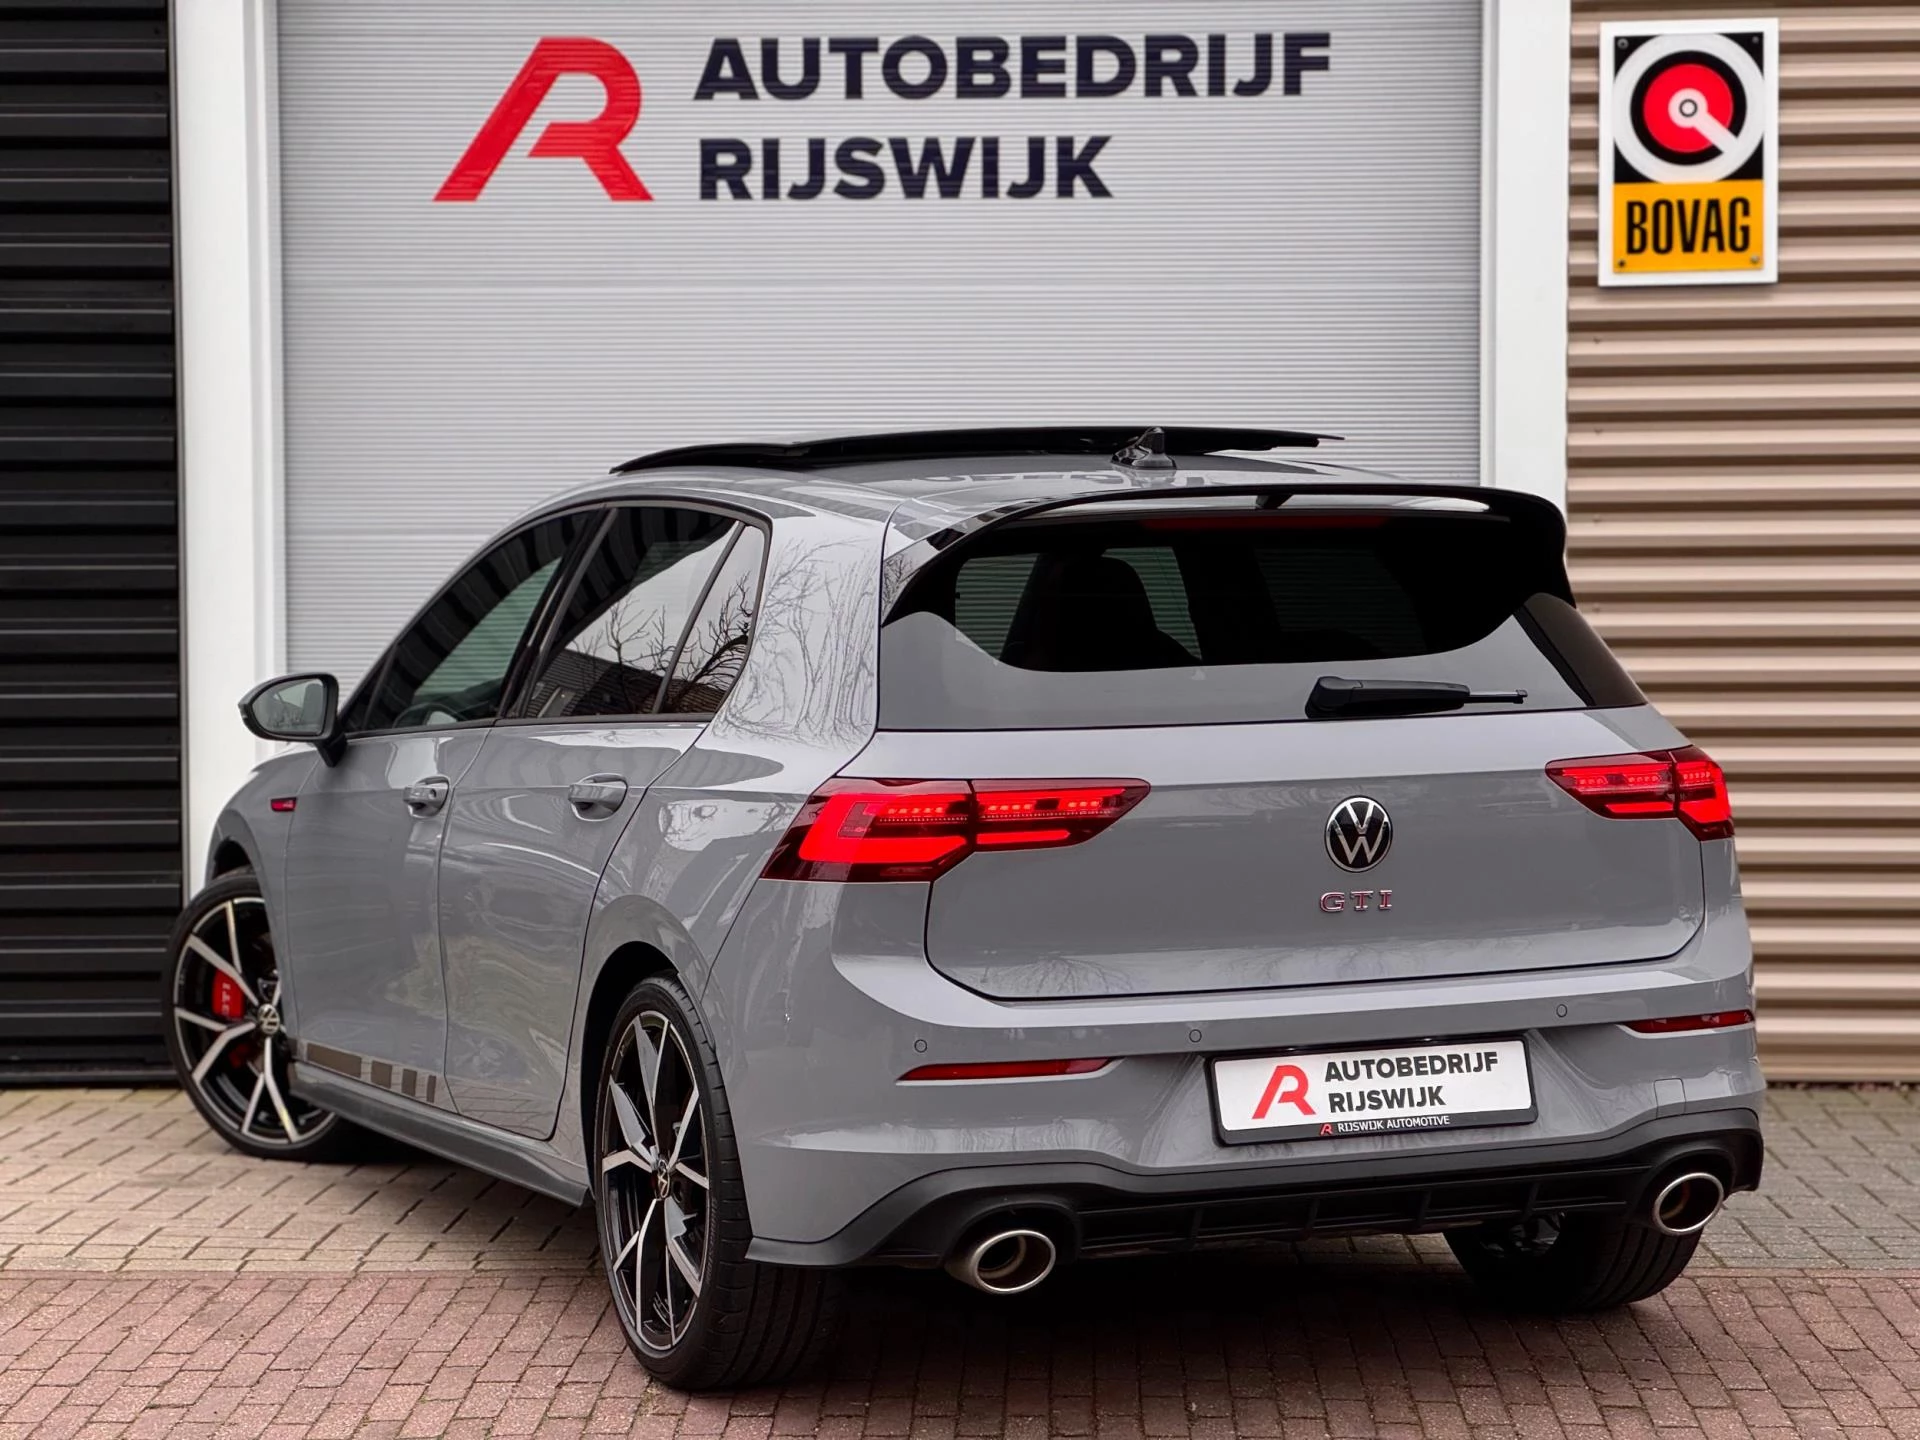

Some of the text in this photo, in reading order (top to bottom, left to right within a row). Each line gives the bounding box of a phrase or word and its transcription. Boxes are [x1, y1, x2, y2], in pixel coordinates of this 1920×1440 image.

[694, 32, 1331, 101] AUTOBEDRIJF
[700, 135, 1115, 201] RIJSWIJK
[1626, 197, 1751, 255] BOVAG
[1320, 889, 1393, 912] GTI
[1324, 1052, 1499, 1082] AUTOBEDRIJF
[1328, 1086, 1446, 1113] RIJSWIJK
[1337, 1120, 1384, 1133] RIJSWIJK
[1386, 1115, 1451, 1129] AUTOMOTIVE
